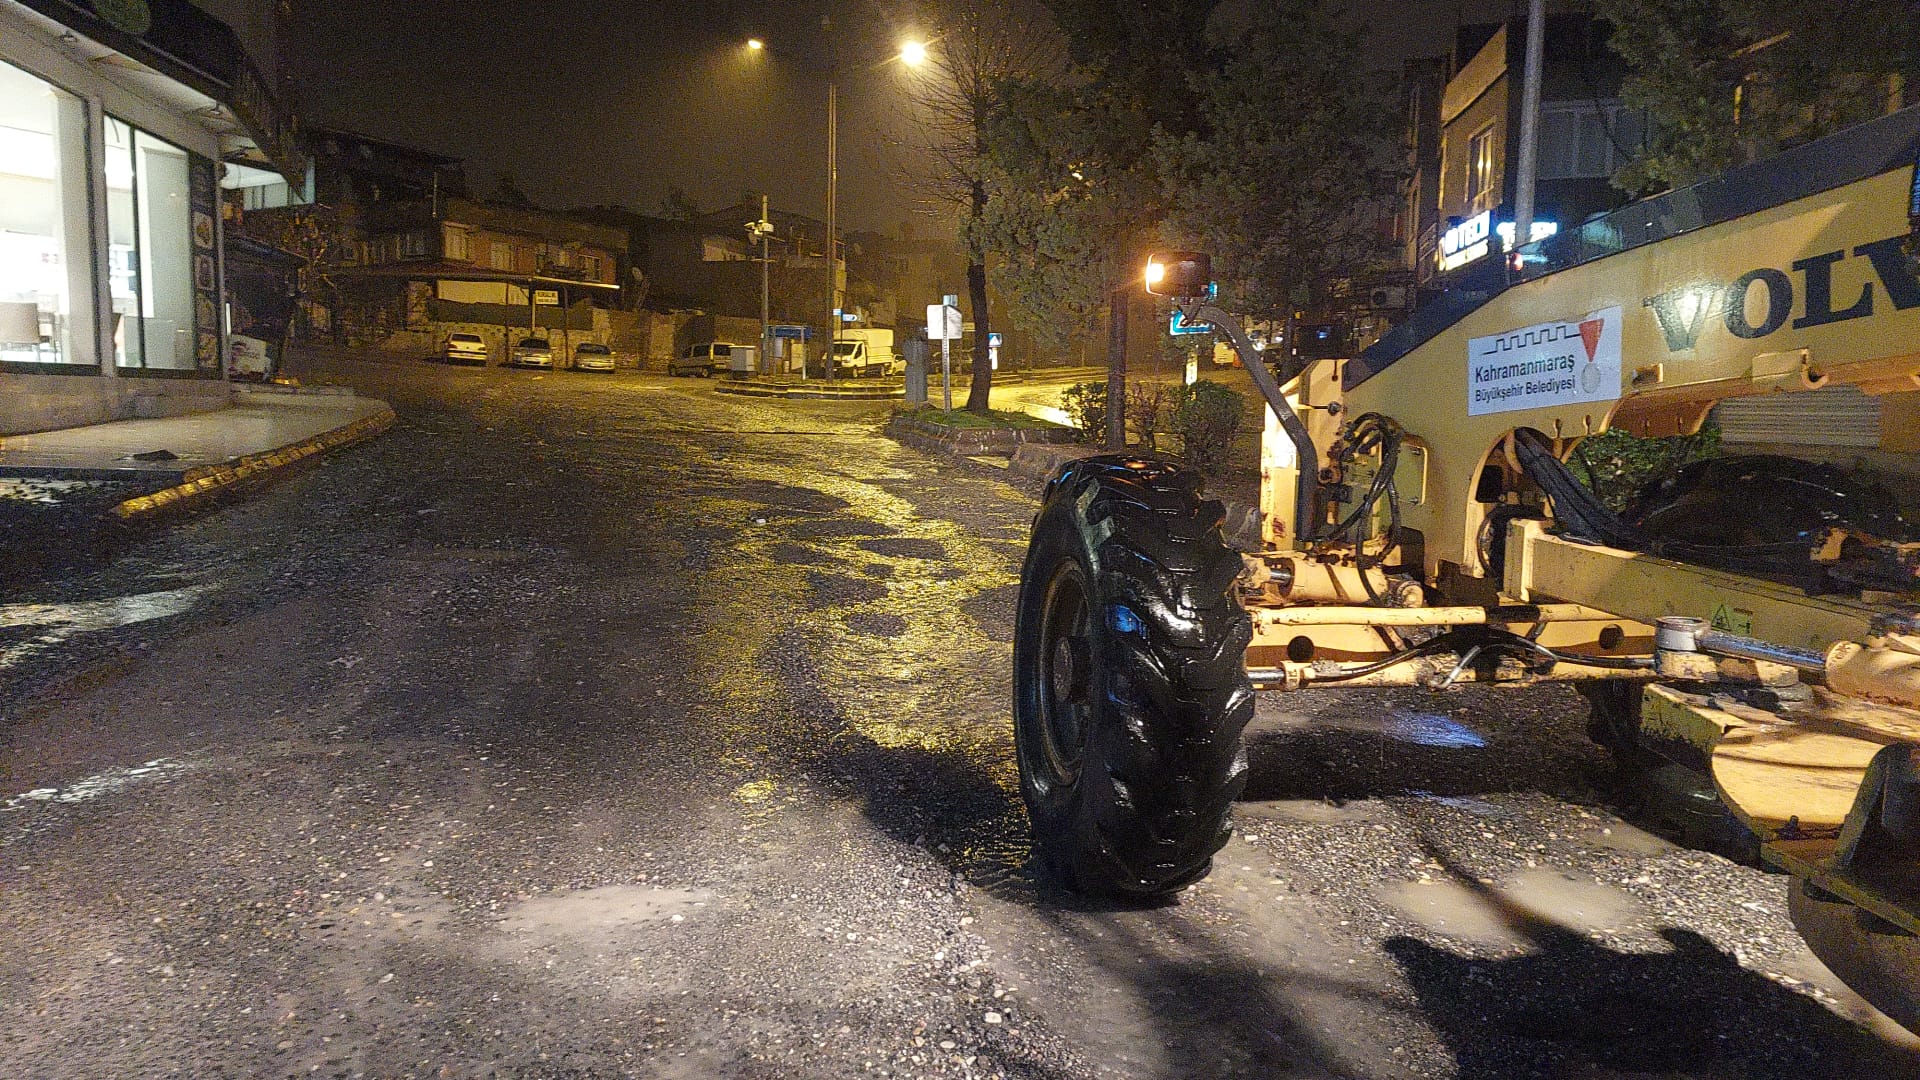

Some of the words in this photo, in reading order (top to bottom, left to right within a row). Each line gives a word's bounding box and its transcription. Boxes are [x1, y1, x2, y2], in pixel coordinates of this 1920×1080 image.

[1475, 354, 1576, 383] Kahramanmaraş
[1475, 383, 1524, 403] Büyükşehir
[1525, 375, 1576, 395] Belediyesi
